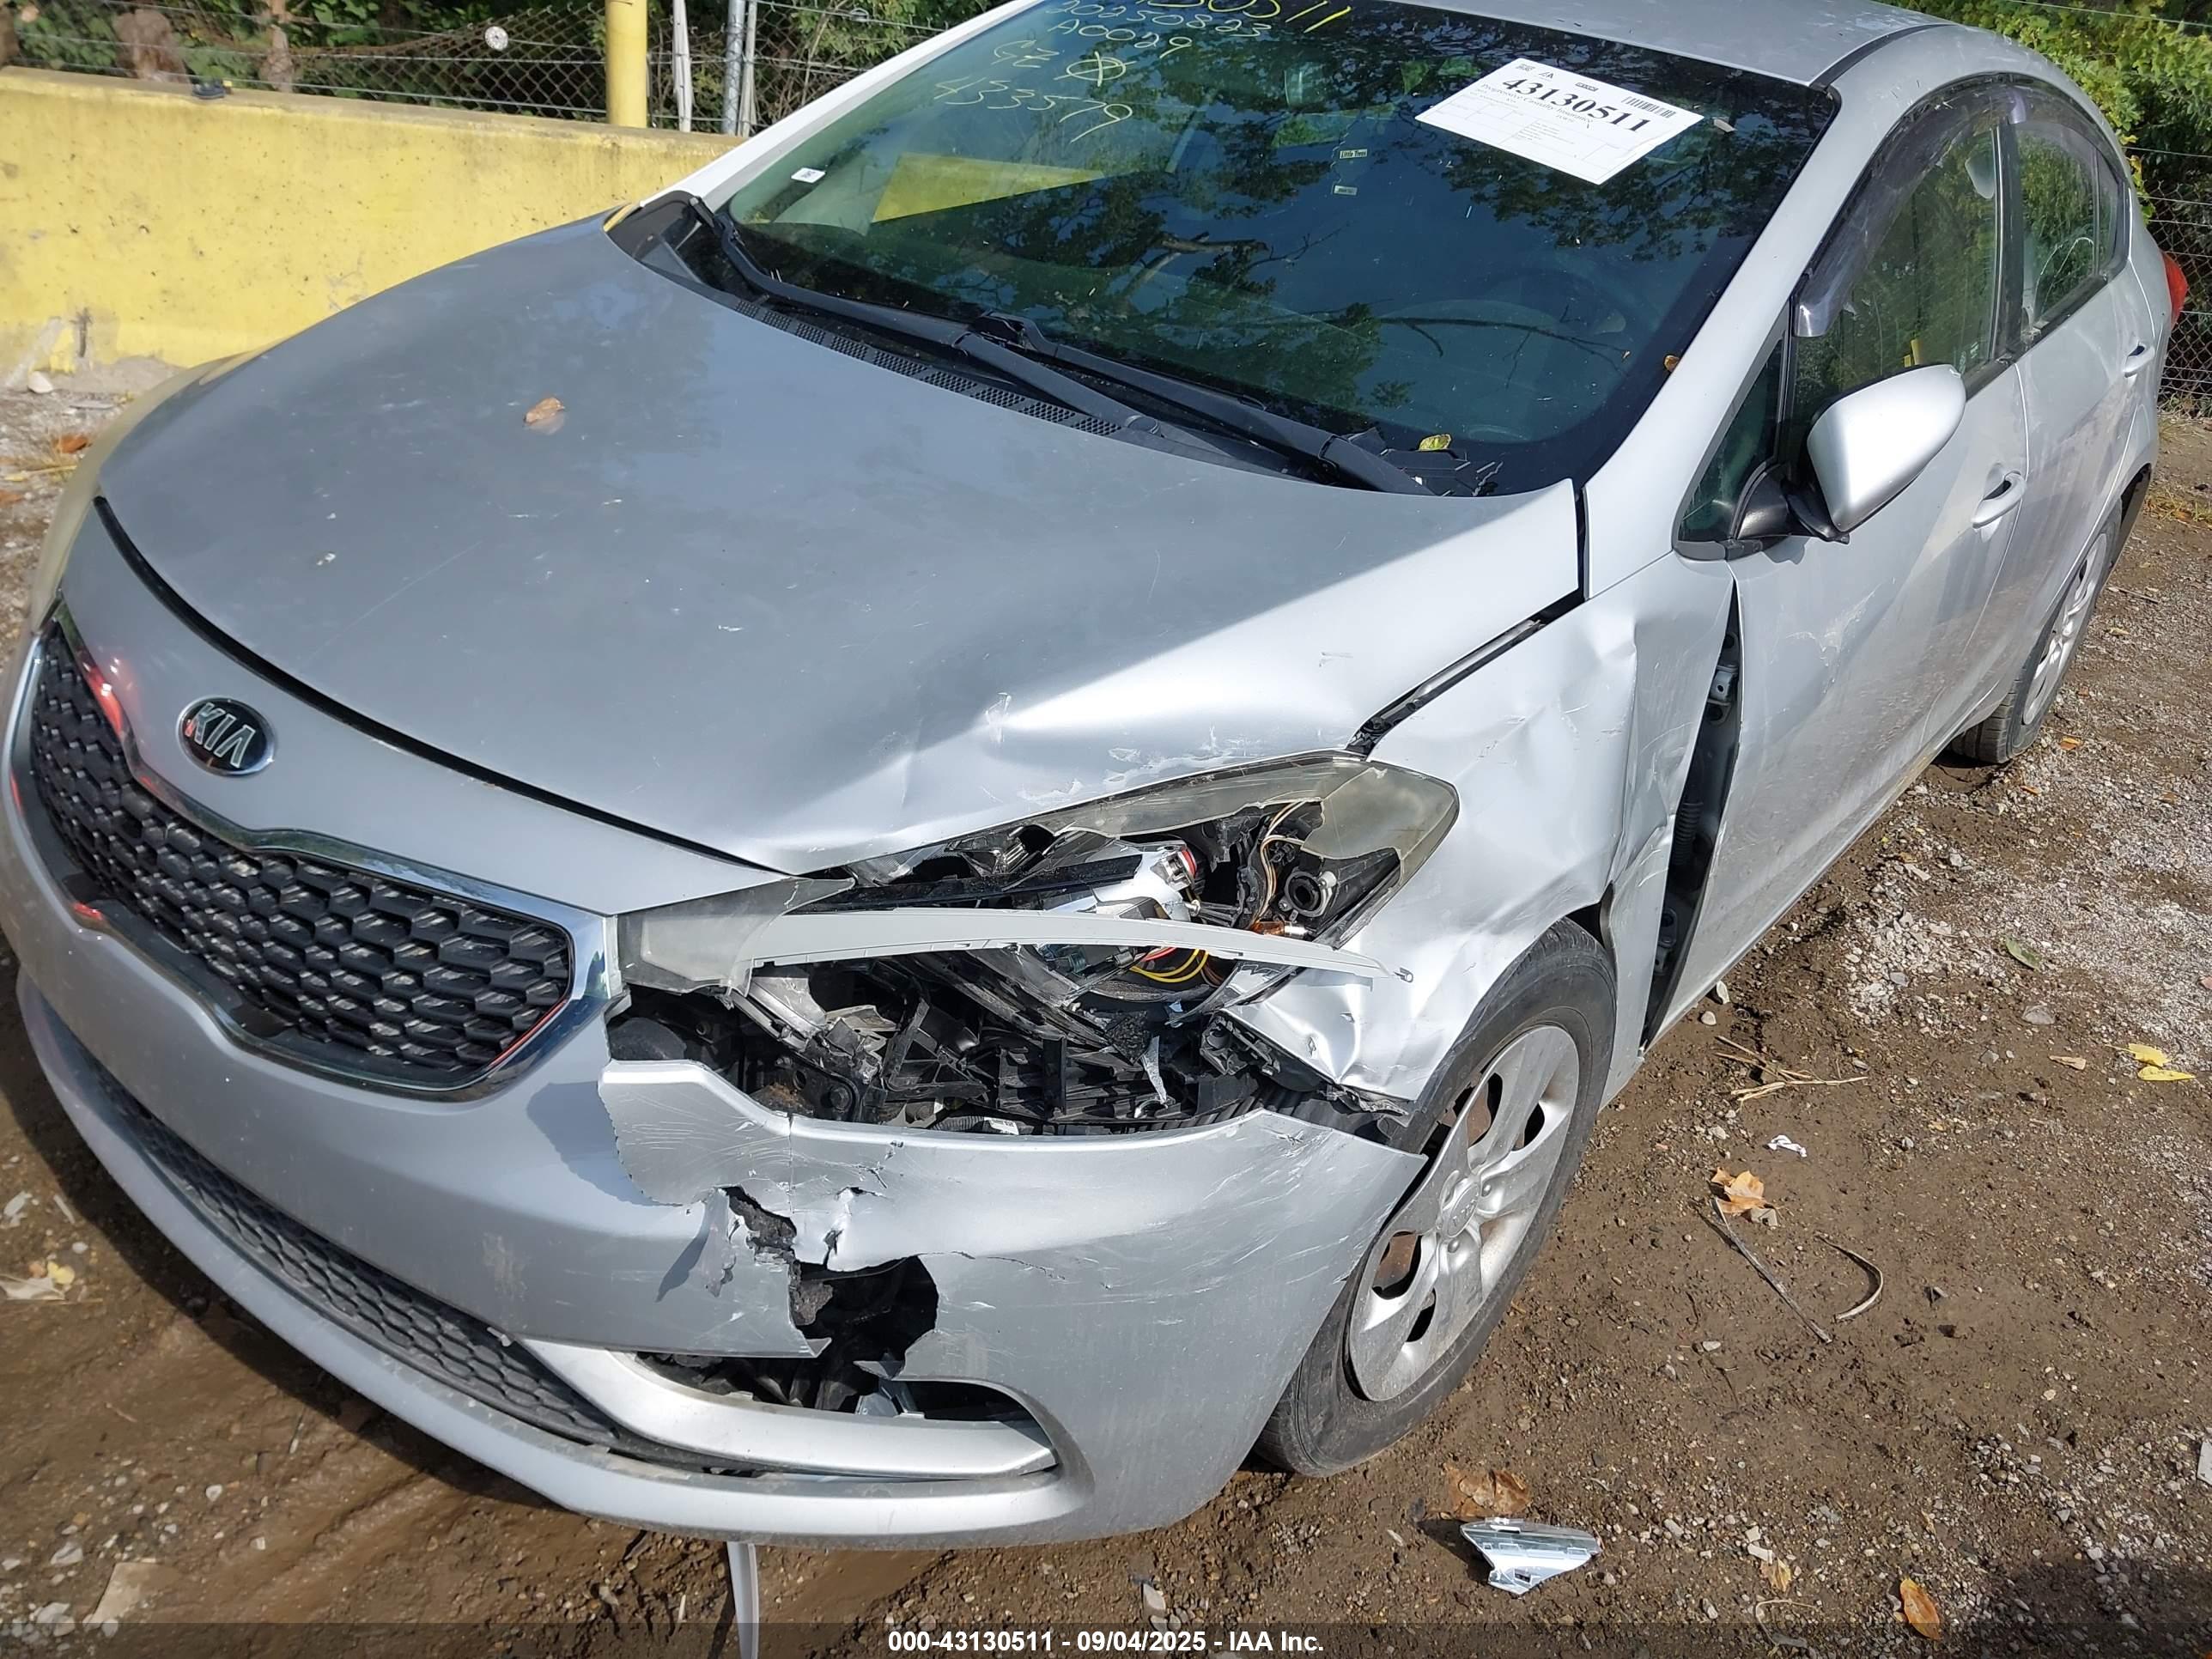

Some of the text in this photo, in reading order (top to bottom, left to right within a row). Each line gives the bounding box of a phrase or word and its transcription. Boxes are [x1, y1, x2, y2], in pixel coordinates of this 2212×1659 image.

[1047, 18, 1194, 58] A0029
[1502, 78, 1651, 132] 43130511
[184, 702, 256, 769] KIA
